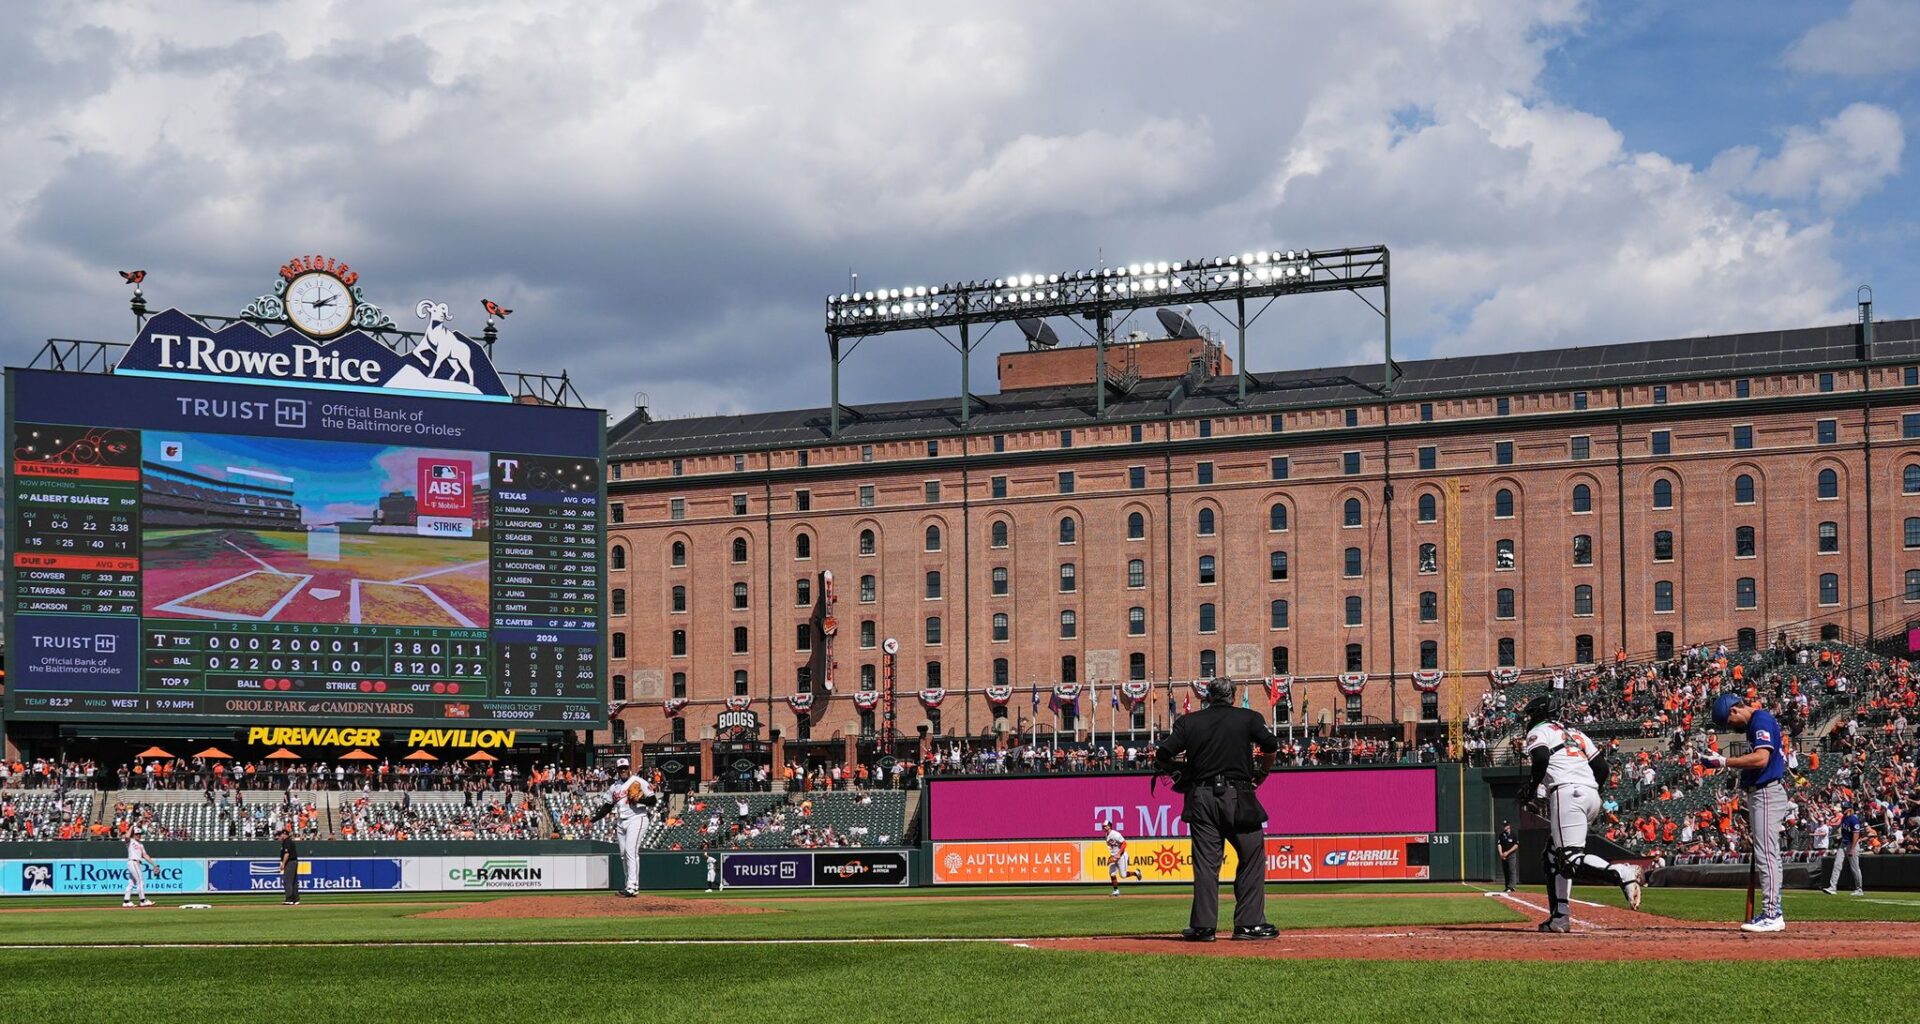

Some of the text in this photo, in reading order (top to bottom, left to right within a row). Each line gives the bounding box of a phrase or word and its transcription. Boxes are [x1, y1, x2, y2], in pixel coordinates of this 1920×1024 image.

[279, 255, 358, 284] ORIOLES
[292, 345, 381, 383] Price
[176, 398, 268, 420] TRUIST
[322, 404, 423, 421] Official Bank of
[322, 418, 462, 436] the Baltimore Orioles
[21, 465, 79, 475] BALTIMORE
[497, 459, 518, 482] T
[428, 481, 462, 495] ABS
[30, 494, 68, 503] ALBERT
[70, 495, 109, 505] SUÁREZ
[434, 522, 462, 532] STRIKE
[30, 587, 65, 595] TAVERAS
[32, 636, 91, 648] TRUIST
[210, 637, 219, 648] 0
[230, 638, 239, 649] 0
[250, 638, 259, 650] 0
[272, 639, 280, 650] 2
[291, 640, 300, 650] 0
[310, 640, 319, 651] 0
[332, 640, 341, 652] 0
[353, 641, 358, 652] 1
[394, 642, 403, 653] 3
[413, 643, 422, 654] 8
[431, 644, 440, 655] 0
[456, 645, 462, 655] 1
[475, 645, 480, 656] 1
[210, 657, 219, 668] 0
[230, 658, 239, 669] 2
[250, 658, 259, 670] 2
[272, 659, 281, 670] 0
[292, 660, 300, 670] 3
[312, 660, 318, 670] 1
[332, 660, 341, 672] 0
[351, 660, 360, 672] 0
[394, 662, 403, 673] 8
[411, 662, 424, 674] 12
[431, 663, 440, 674] 0
[455, 664, 464, 675] 2
[474, 664, 482, 675] 2
[326, 682, 357, 690] STRIKE
[226, 700, 414, 714] ORIOLE PARK at CAMDEN YARDS
[562, 712, 590, 720] $7,524
[248, 727, 516, 748] PUREWAGER PAVILION
[1433, 836, 1449, 844] 318
[684, 856, 700, 865] 373
[967, 853, 1071, 865] AUTUMN LAKE
[1348, 850, 1399, 860] CARROLL
[734, 865, 778, 876] TRUIST
[251, 877, 362, 889] Medar Health
